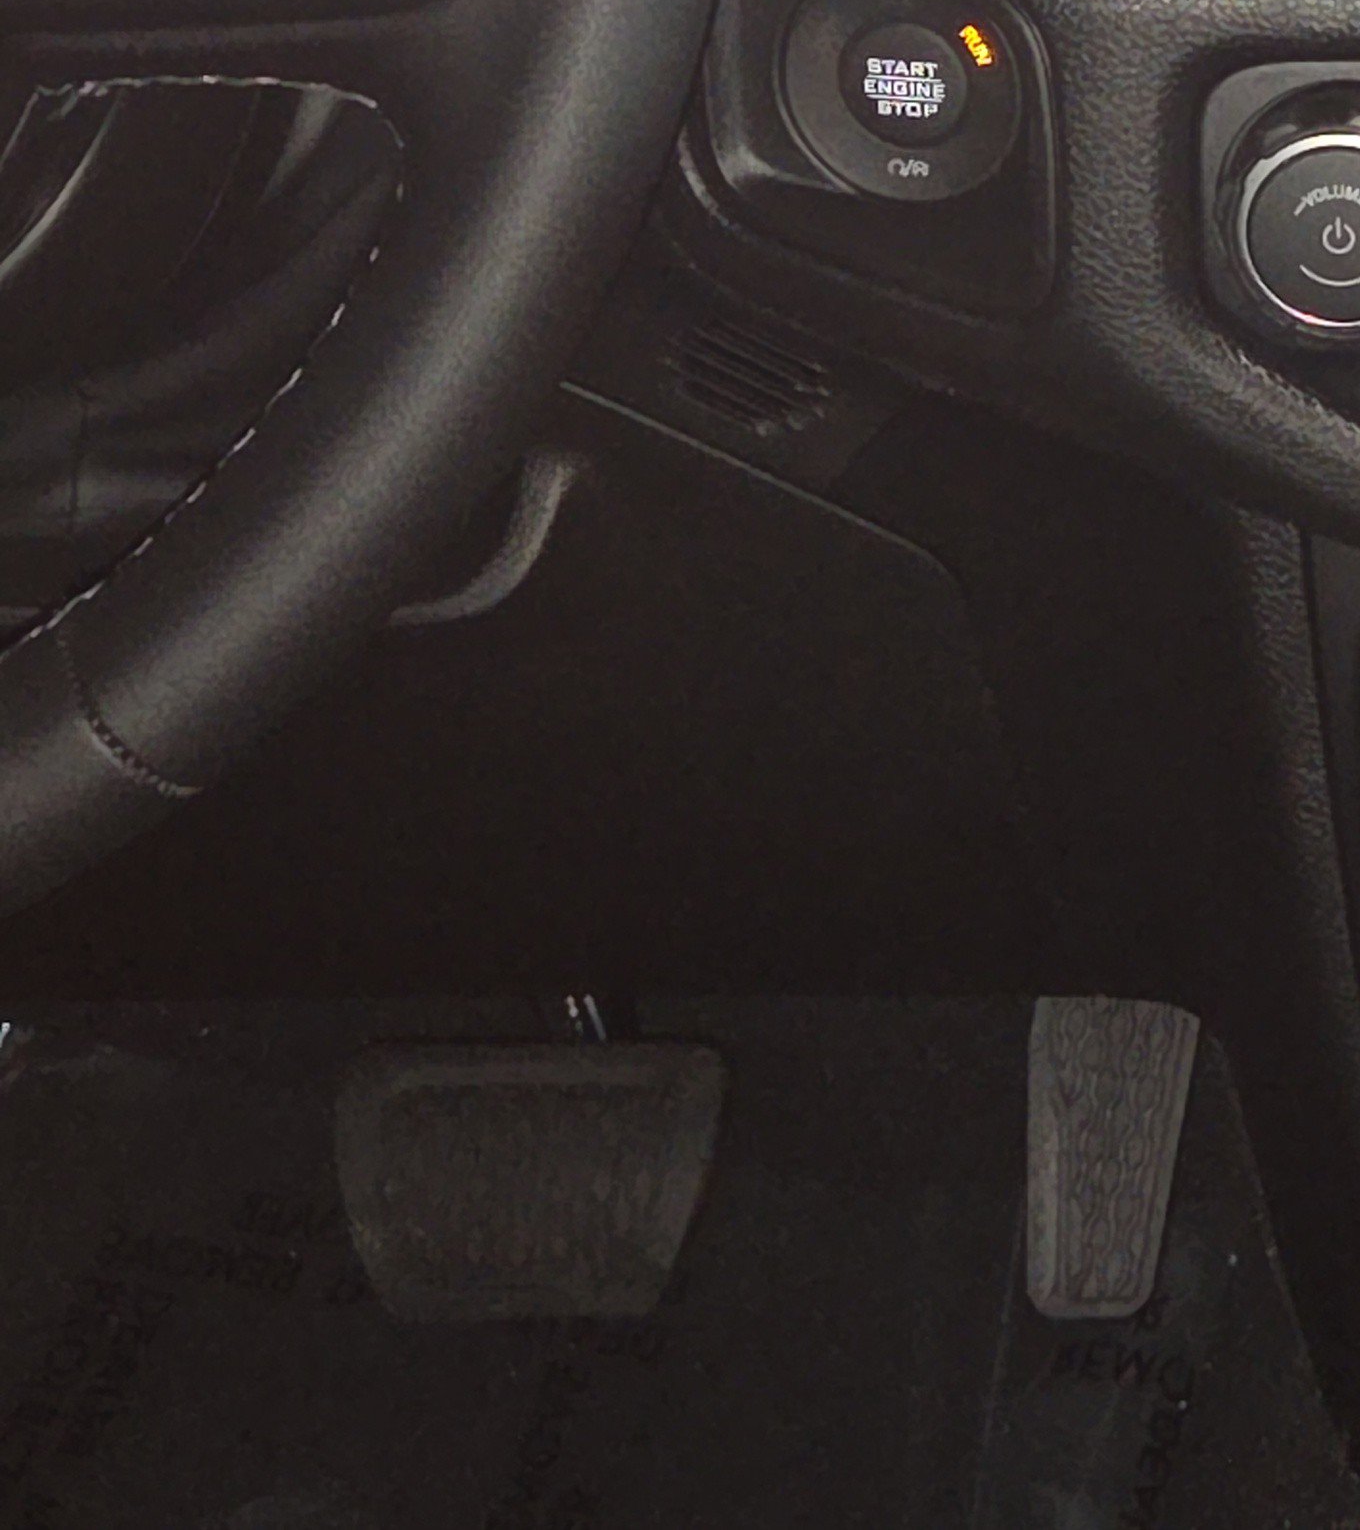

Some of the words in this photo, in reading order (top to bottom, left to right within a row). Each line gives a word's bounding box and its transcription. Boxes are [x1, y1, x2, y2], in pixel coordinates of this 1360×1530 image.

[959, 25, 993, 67] RUN
[866, 57, 938, 78] START
[863, 79, 946, 99] ENGINE
[877, 101, 939, 118] STOP
